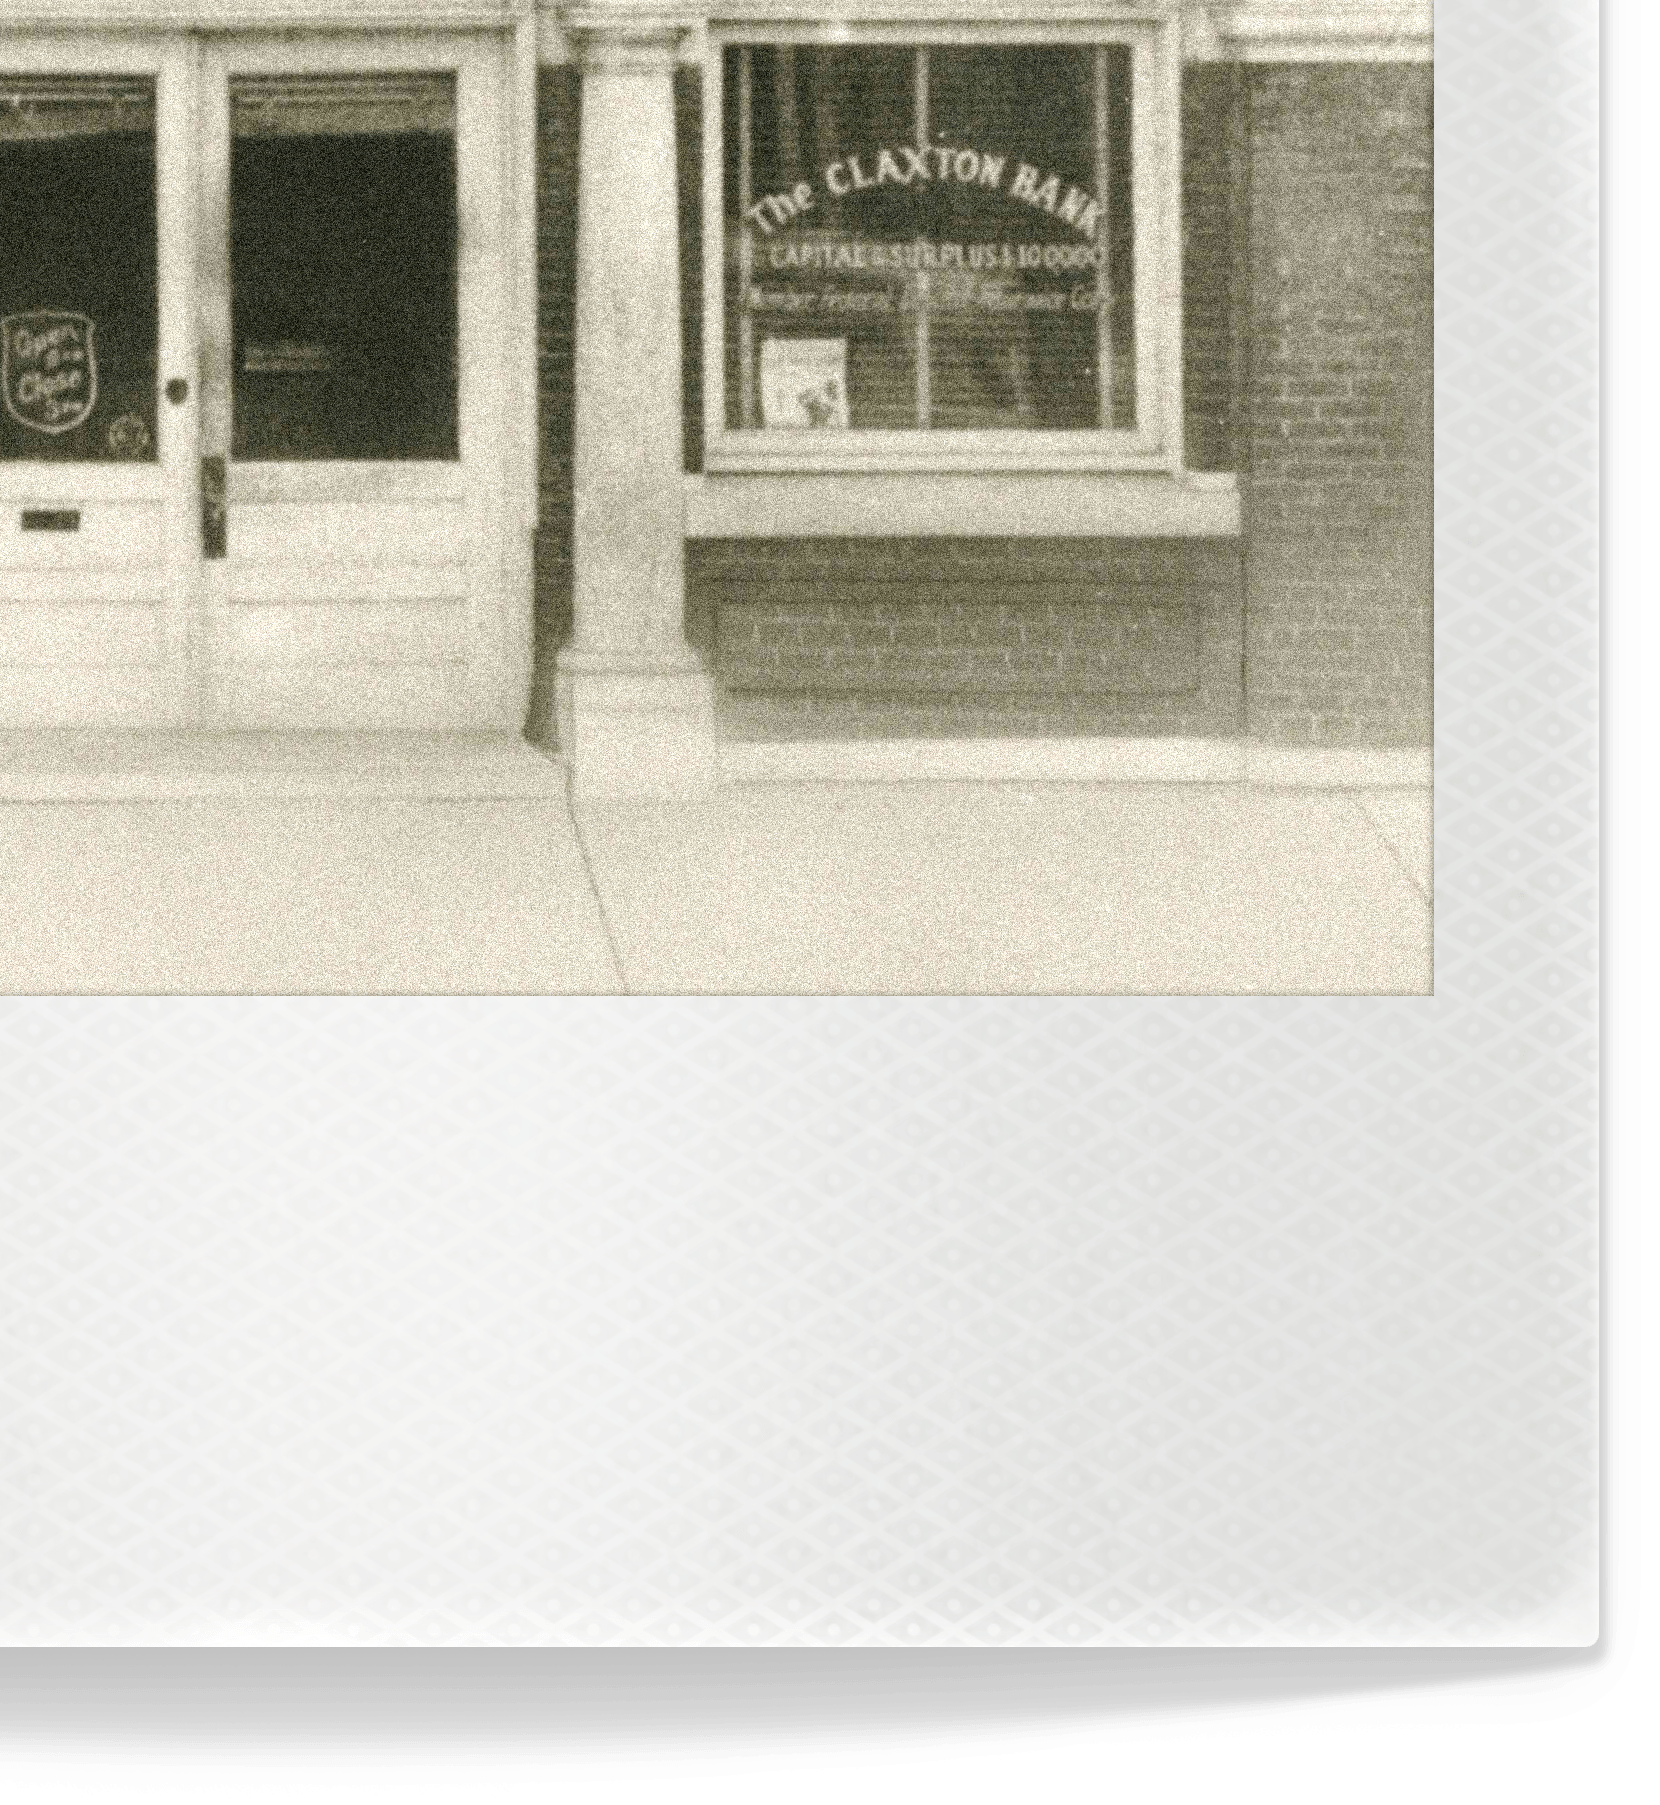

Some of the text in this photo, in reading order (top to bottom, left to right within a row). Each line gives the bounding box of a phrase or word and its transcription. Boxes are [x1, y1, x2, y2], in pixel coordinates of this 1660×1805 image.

[746, 147, 1105, 240] The CLAXTON BANK
[769, 242, 866, 269] CAPITAL
[890, 241, 998, 270] SURPLUS
